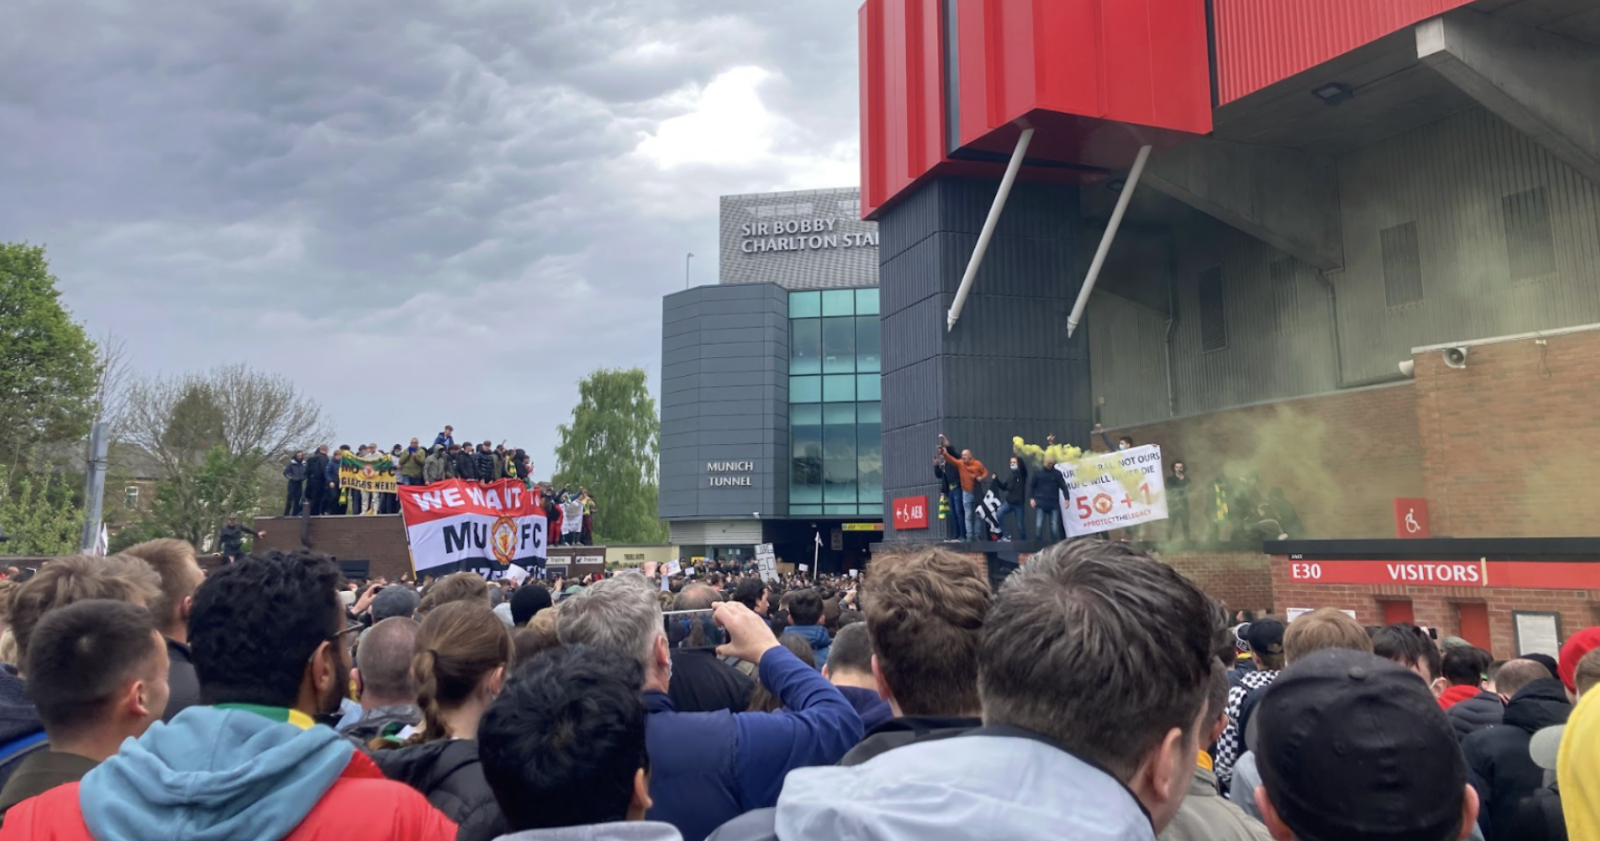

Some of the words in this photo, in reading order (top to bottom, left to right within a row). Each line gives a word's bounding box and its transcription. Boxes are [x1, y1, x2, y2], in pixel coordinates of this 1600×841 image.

[741, 222, 769, 237] SIR
[773, 217, 836, 235] BOBBY
[741, 234, 838, 254] CHARLTON
[707, 461, 754, 472] MUNICH
[1118, 456, 1136, 467] NOT
[1137, 452, 1161, 463] OURS
[708, 476, 753, 487] TUNNEL
[1091, 474, 1112, 485] WILL
[1140, 464, 1156, 476] DIE
[411, 487, 465, 512] WE
[465, 486, 521, 510] WANT
[1140, 482, 1152, 506] 1
[911, 505, 924, 519] AEB
[1083, 508, 1152, 528] #PROTECTTHELEGACY
[442, 521, 487, 554] MU
[520, 522, 542, 550] FC
[1292, 563, 1322, 579] E30
[1386, 563, 1480, 582] VISITORS
